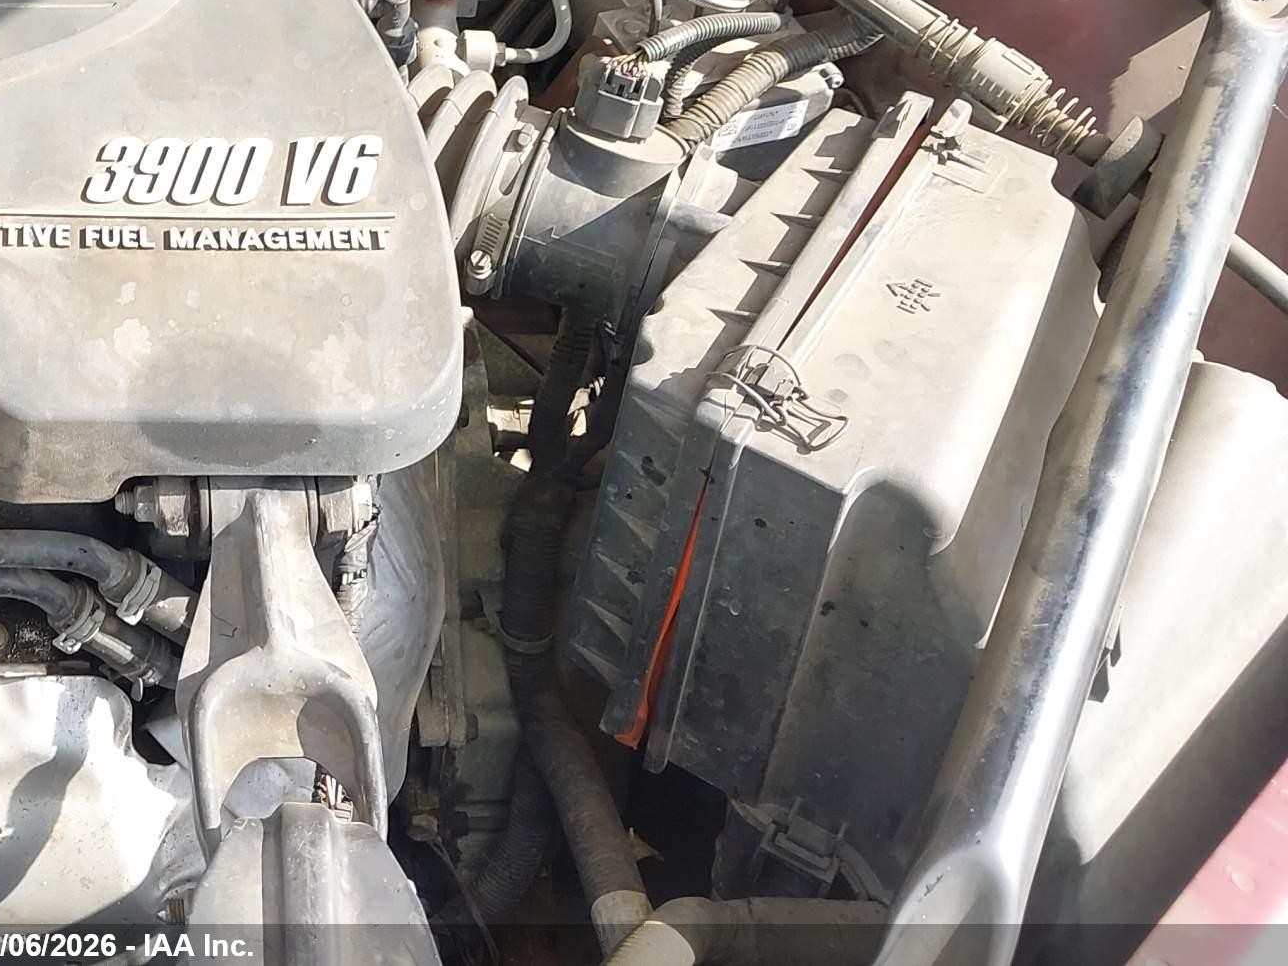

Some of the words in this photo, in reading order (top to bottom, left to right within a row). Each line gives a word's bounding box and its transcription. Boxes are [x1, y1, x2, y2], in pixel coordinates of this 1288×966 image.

[81, 136, 273, 206] 3900
[281, 134, 383, 206] V6
[80, 225, 156, 249] FUEL
[163, 226, 391, 251] MANAGEMENT
